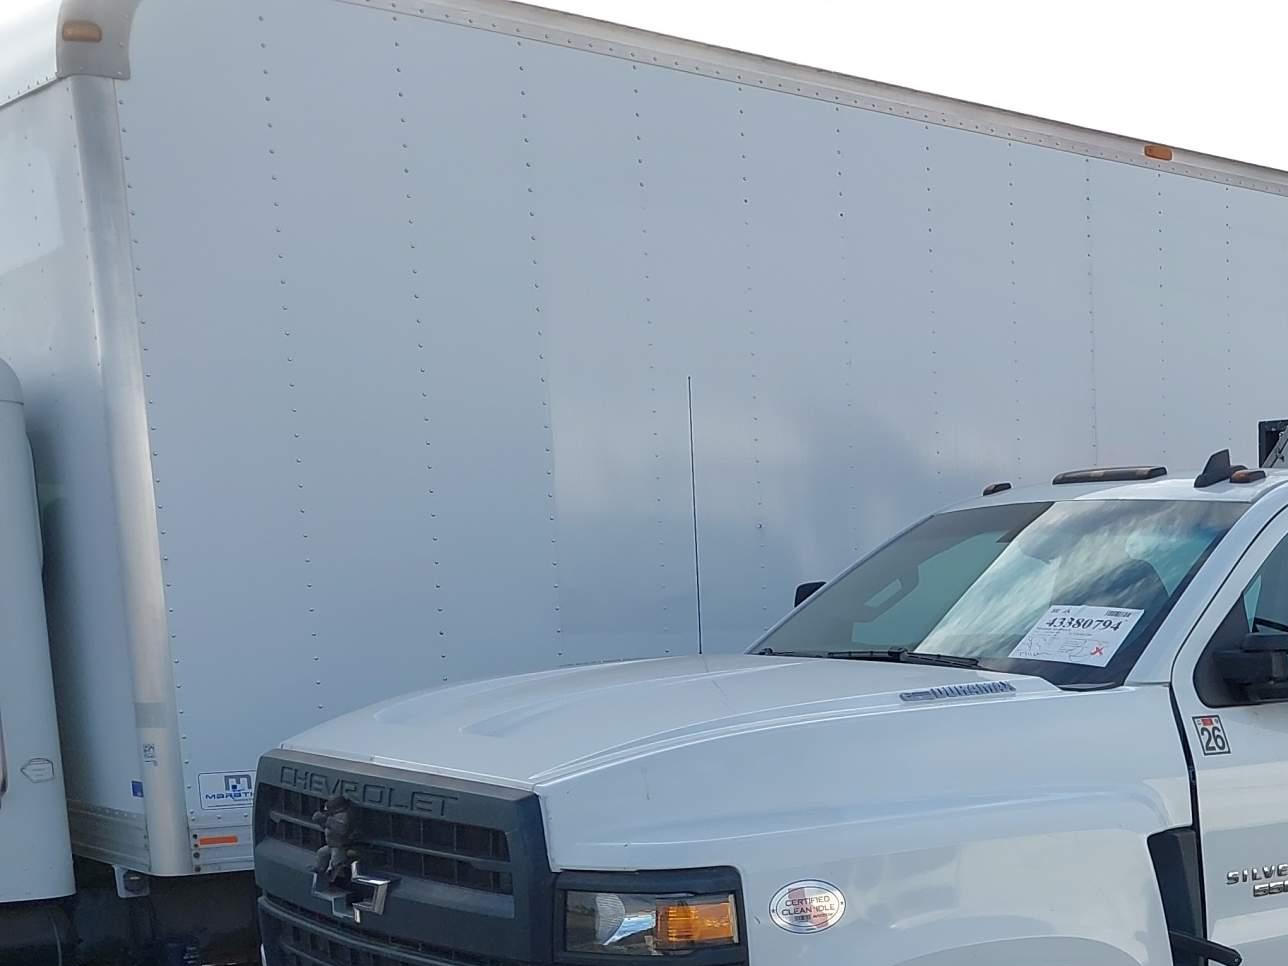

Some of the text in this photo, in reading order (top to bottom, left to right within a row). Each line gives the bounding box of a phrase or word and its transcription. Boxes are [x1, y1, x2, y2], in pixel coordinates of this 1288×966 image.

[1045, 616, 1122, 632] 43380794
[1200, 726, 1226, 752] 26
[280, 765, 459, 817] CHEVROLET
[784, 895, 831, 907] CERTIFIED
[781, 905, 813, 916] CLEAN
